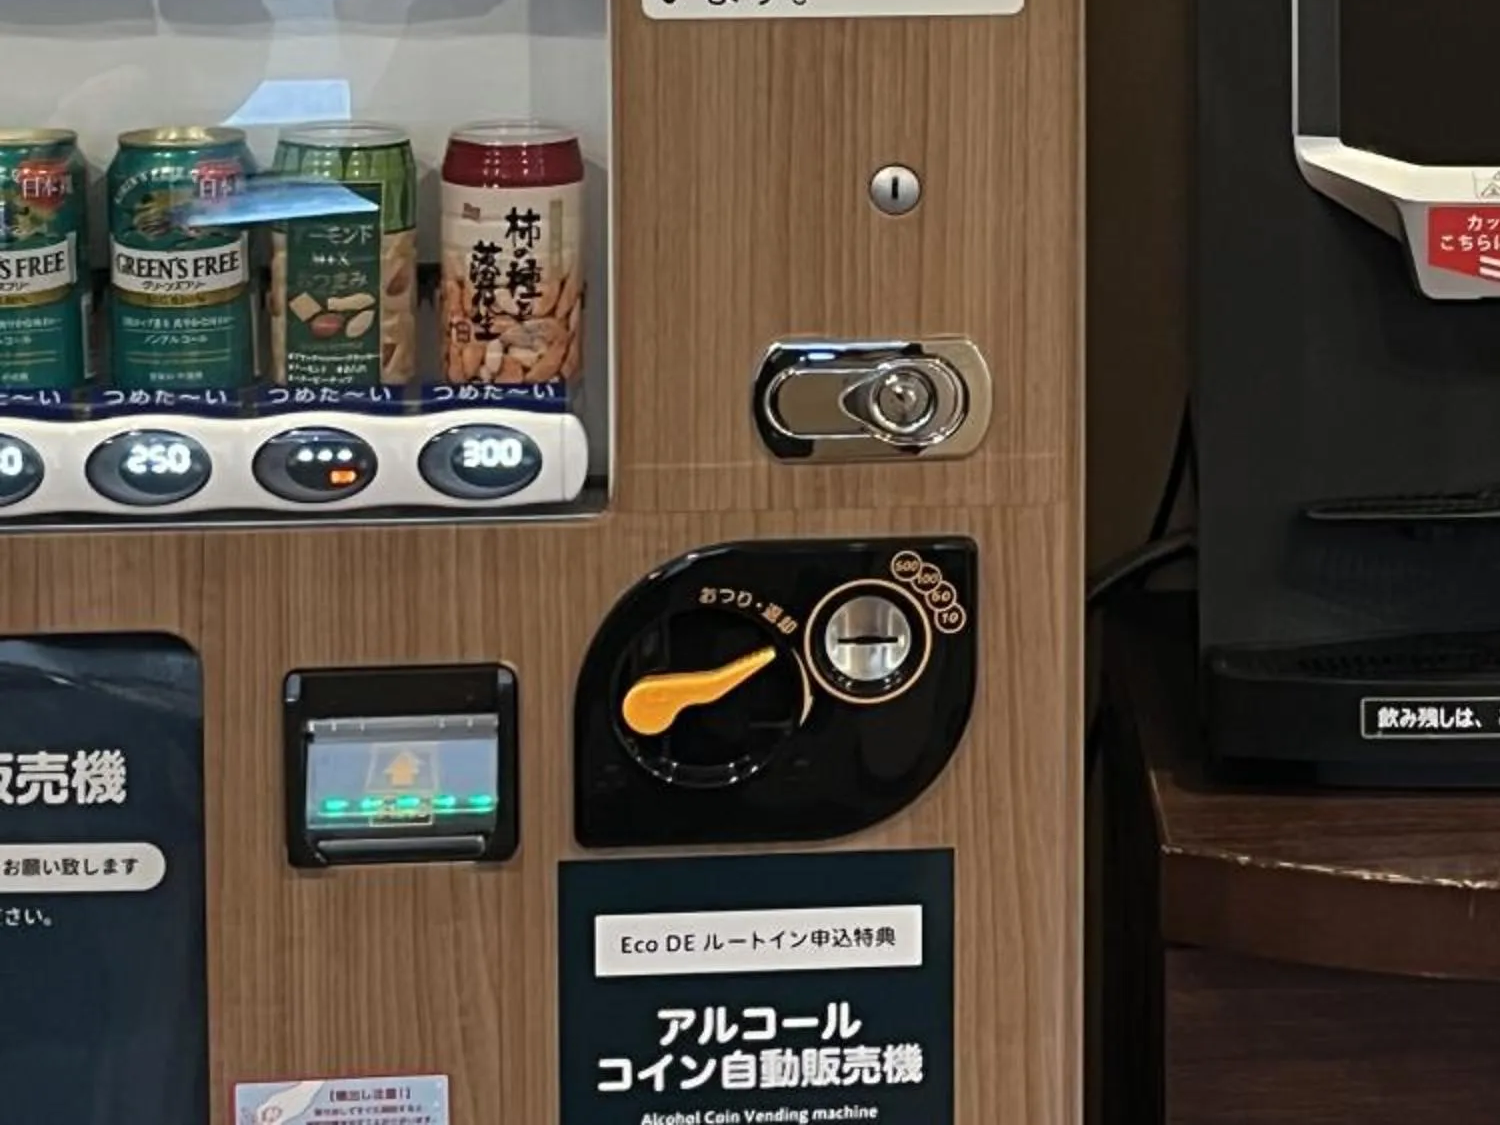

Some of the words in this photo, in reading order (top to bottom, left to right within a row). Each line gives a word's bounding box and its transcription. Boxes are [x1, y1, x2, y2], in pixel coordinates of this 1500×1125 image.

[16, 251, 66, 277] FREE
[116, 253, 188, 278] GREEN'S
[193, 250, 240, 276] FREE
[126, 443, 191, 475] 250
[462, 438, 522, 468] 300
[3, 856, 140, 877] お願い致します
[621, 936, 659, 954] Eco
[666, 935, 697, 953] DE
[703, 926, 897, 952] ルートイン申込特典
[657, 1001, 863, 1047] アルコール
[597, 1042, 925, 1094] コイン自動販売機
[641, 1110, 702, 1125] Alcohol
[705, 1109, 741, 1125] Coin
[744, 1107, 810, 1125] Vending
[812, 1103, 879, 1121] machine
